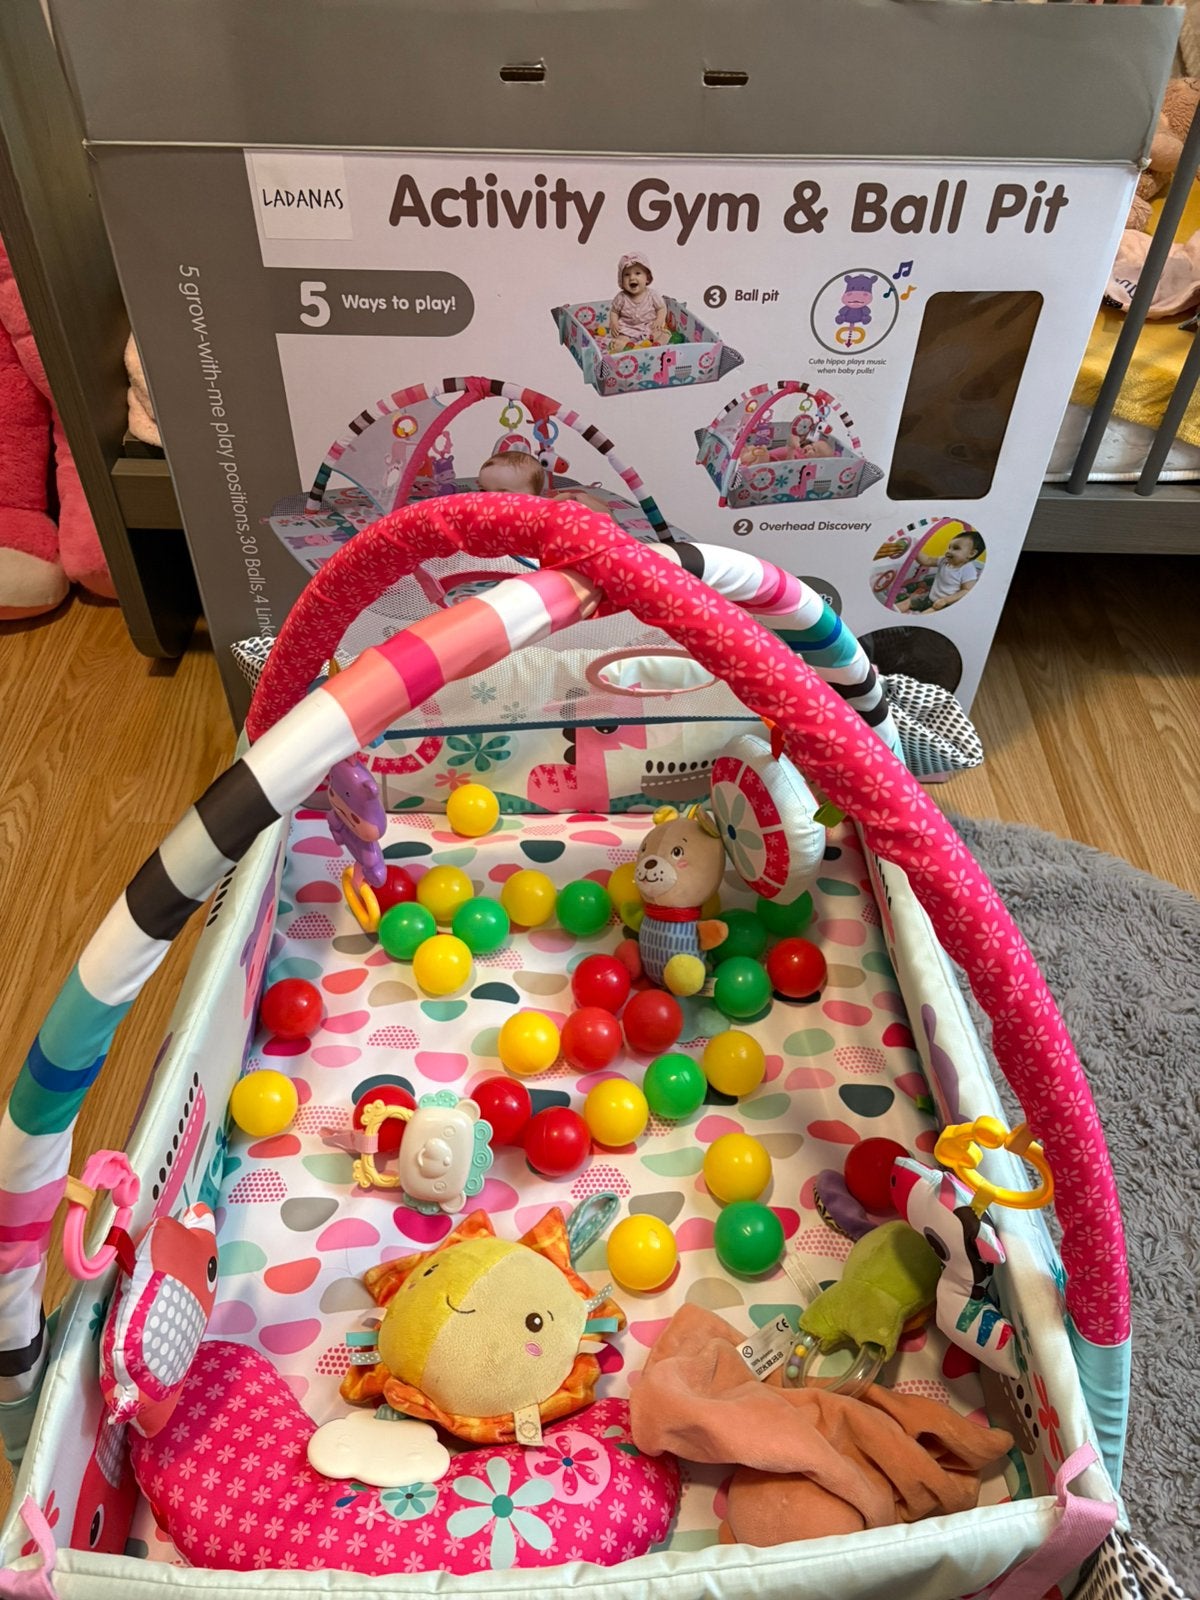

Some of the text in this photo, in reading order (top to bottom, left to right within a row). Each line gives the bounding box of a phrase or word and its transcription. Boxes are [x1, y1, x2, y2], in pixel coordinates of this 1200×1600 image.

[262, 188, 344, 210] LADANAS
[388, 172, 1070, 246] Activity Gym & Ball Pit
[179, 264, 200, 277] 5
[299, 281, 456, 328] 5 Ways to play!
[735, 288, 759, 302] Ball
[762, 289, 780, 305] pit
[178, 282, 226, 418] grow-with-me
[826, 358, 846, 366] hippo
[847, 358, 865, 366] plays
[837, 367, 855, 375] baby
[209, 422, 236, 458] play
[759, 521, 815, 531] Overhead
[818, 521, 872, 532] Discovery
[776, 1318, 789, 1332] CE
